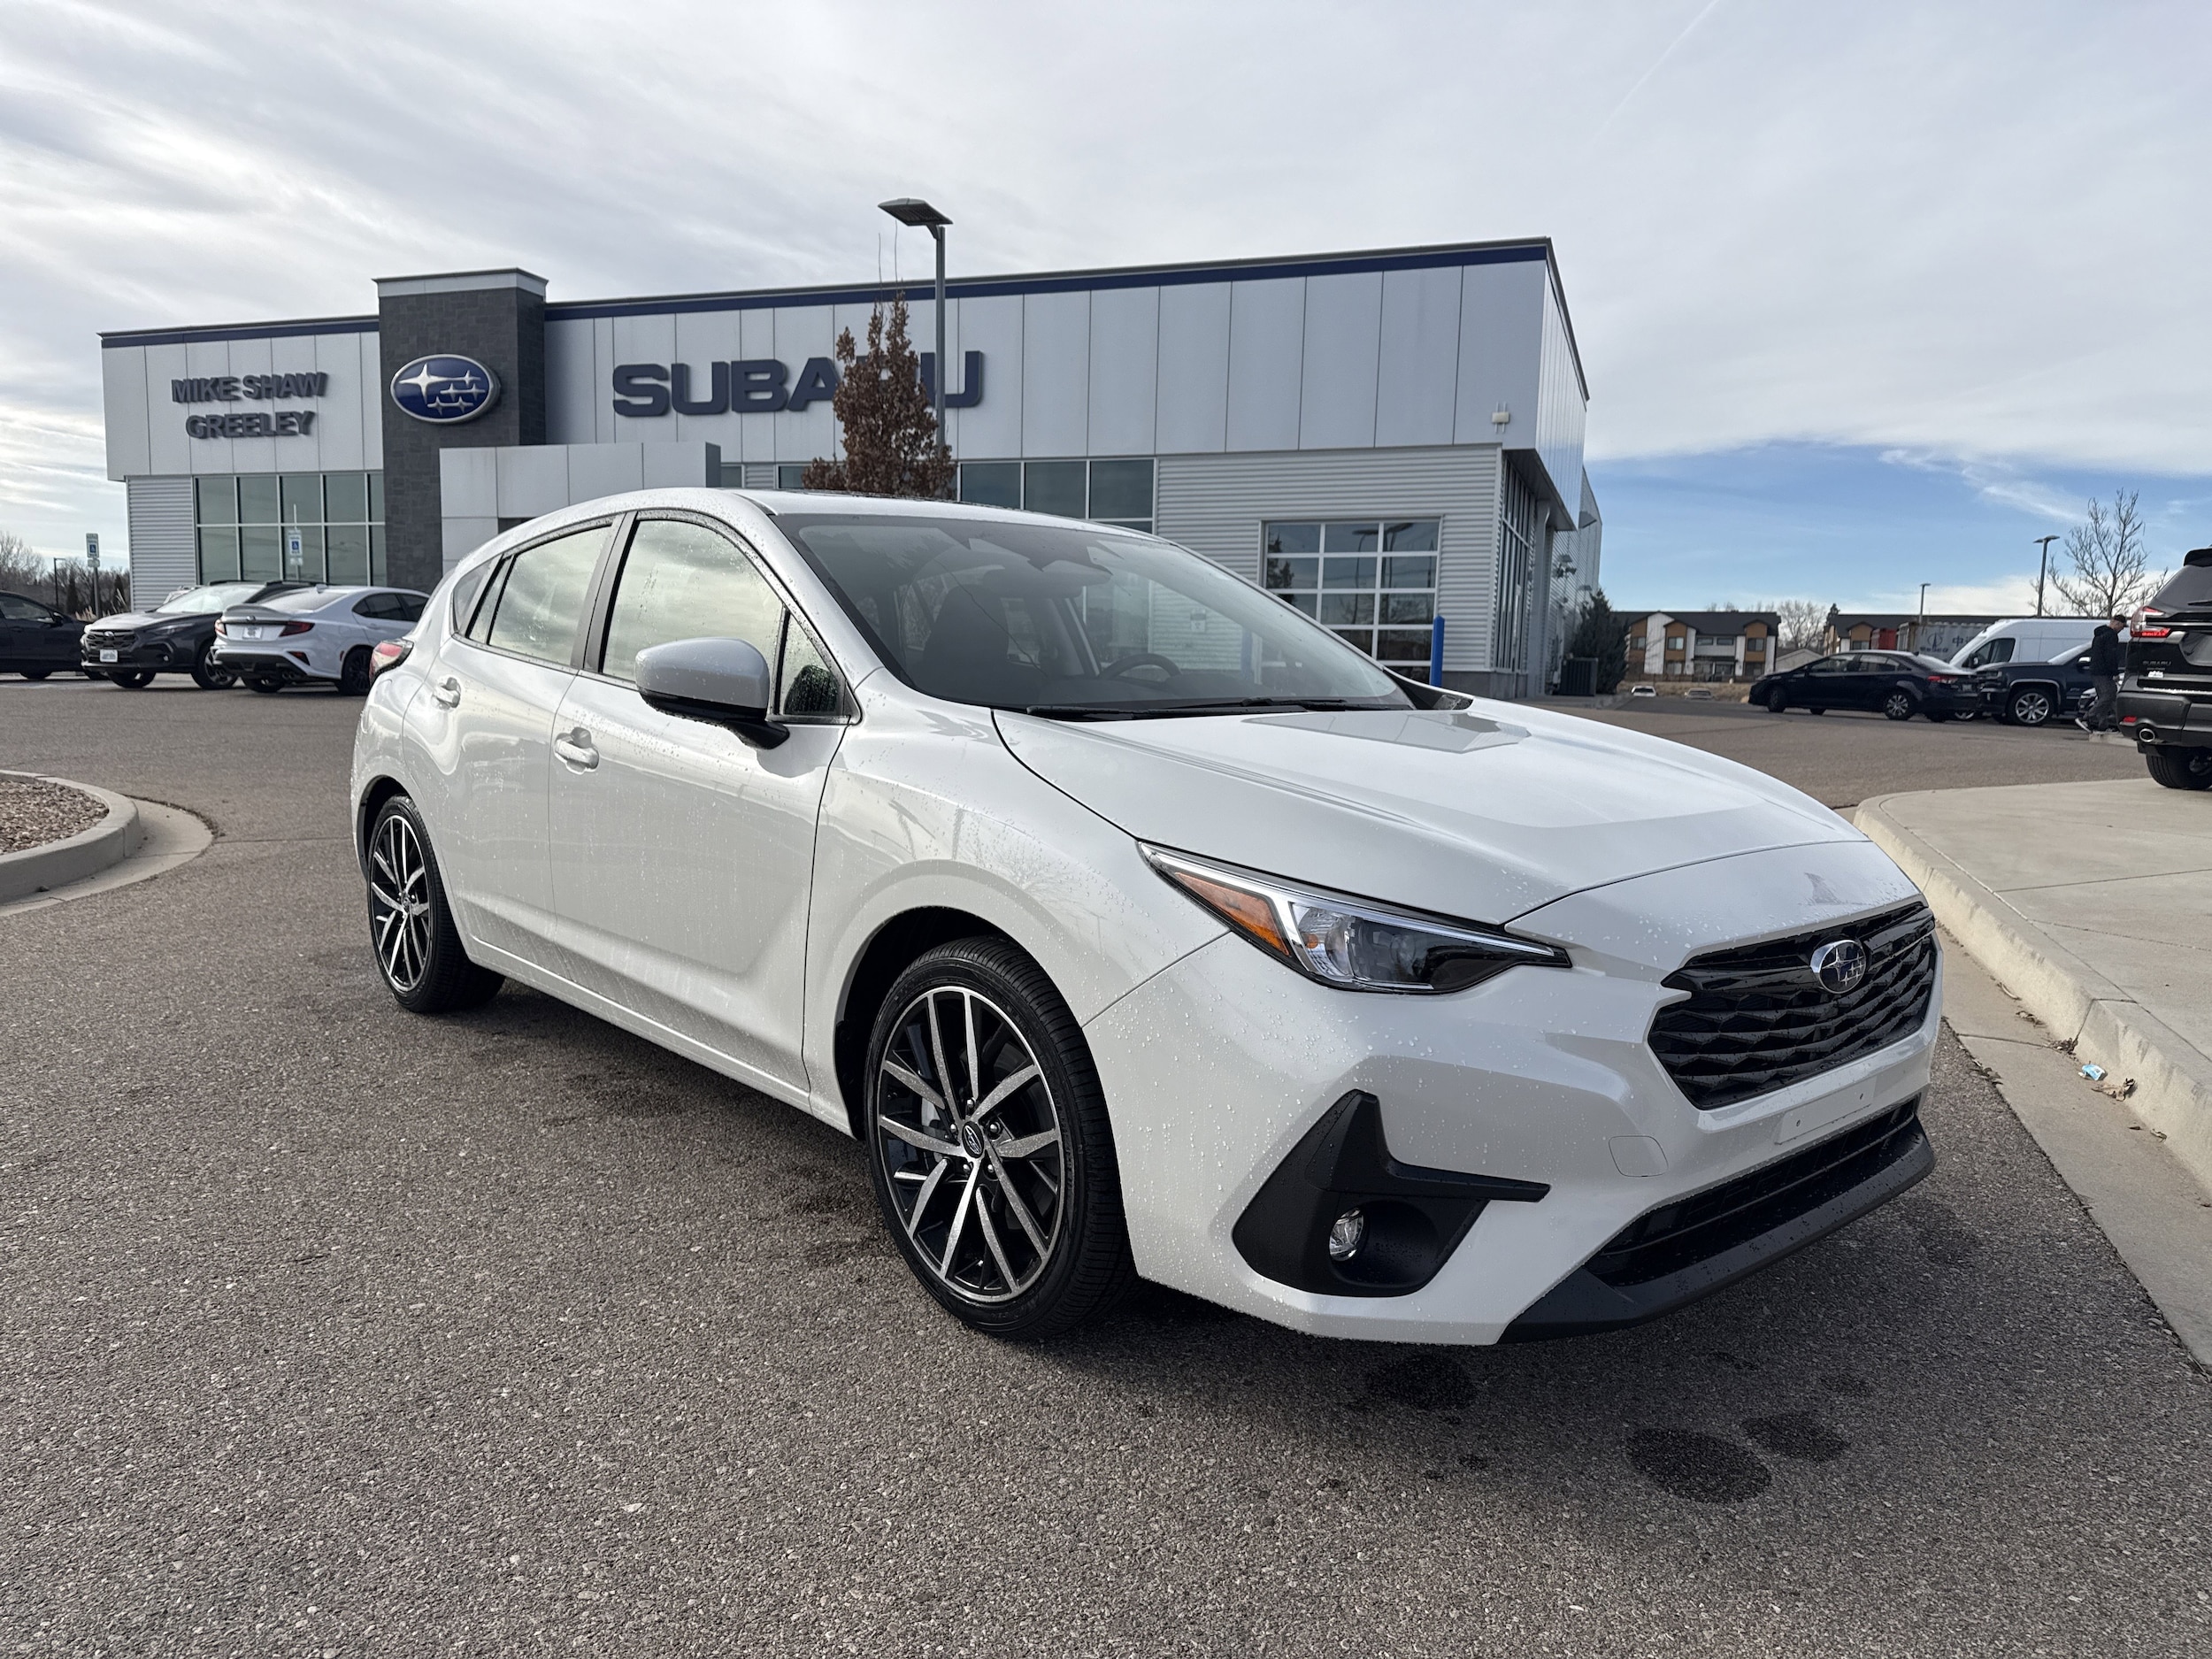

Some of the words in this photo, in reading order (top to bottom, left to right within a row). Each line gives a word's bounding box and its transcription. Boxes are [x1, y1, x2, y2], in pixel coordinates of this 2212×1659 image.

[171, 377, 242, 403] MIKE
[242, 372, 328, 400] SHAW
[612, 350, 984, 417] SUBAU
[185, 411, 316, 440] GREELEY
